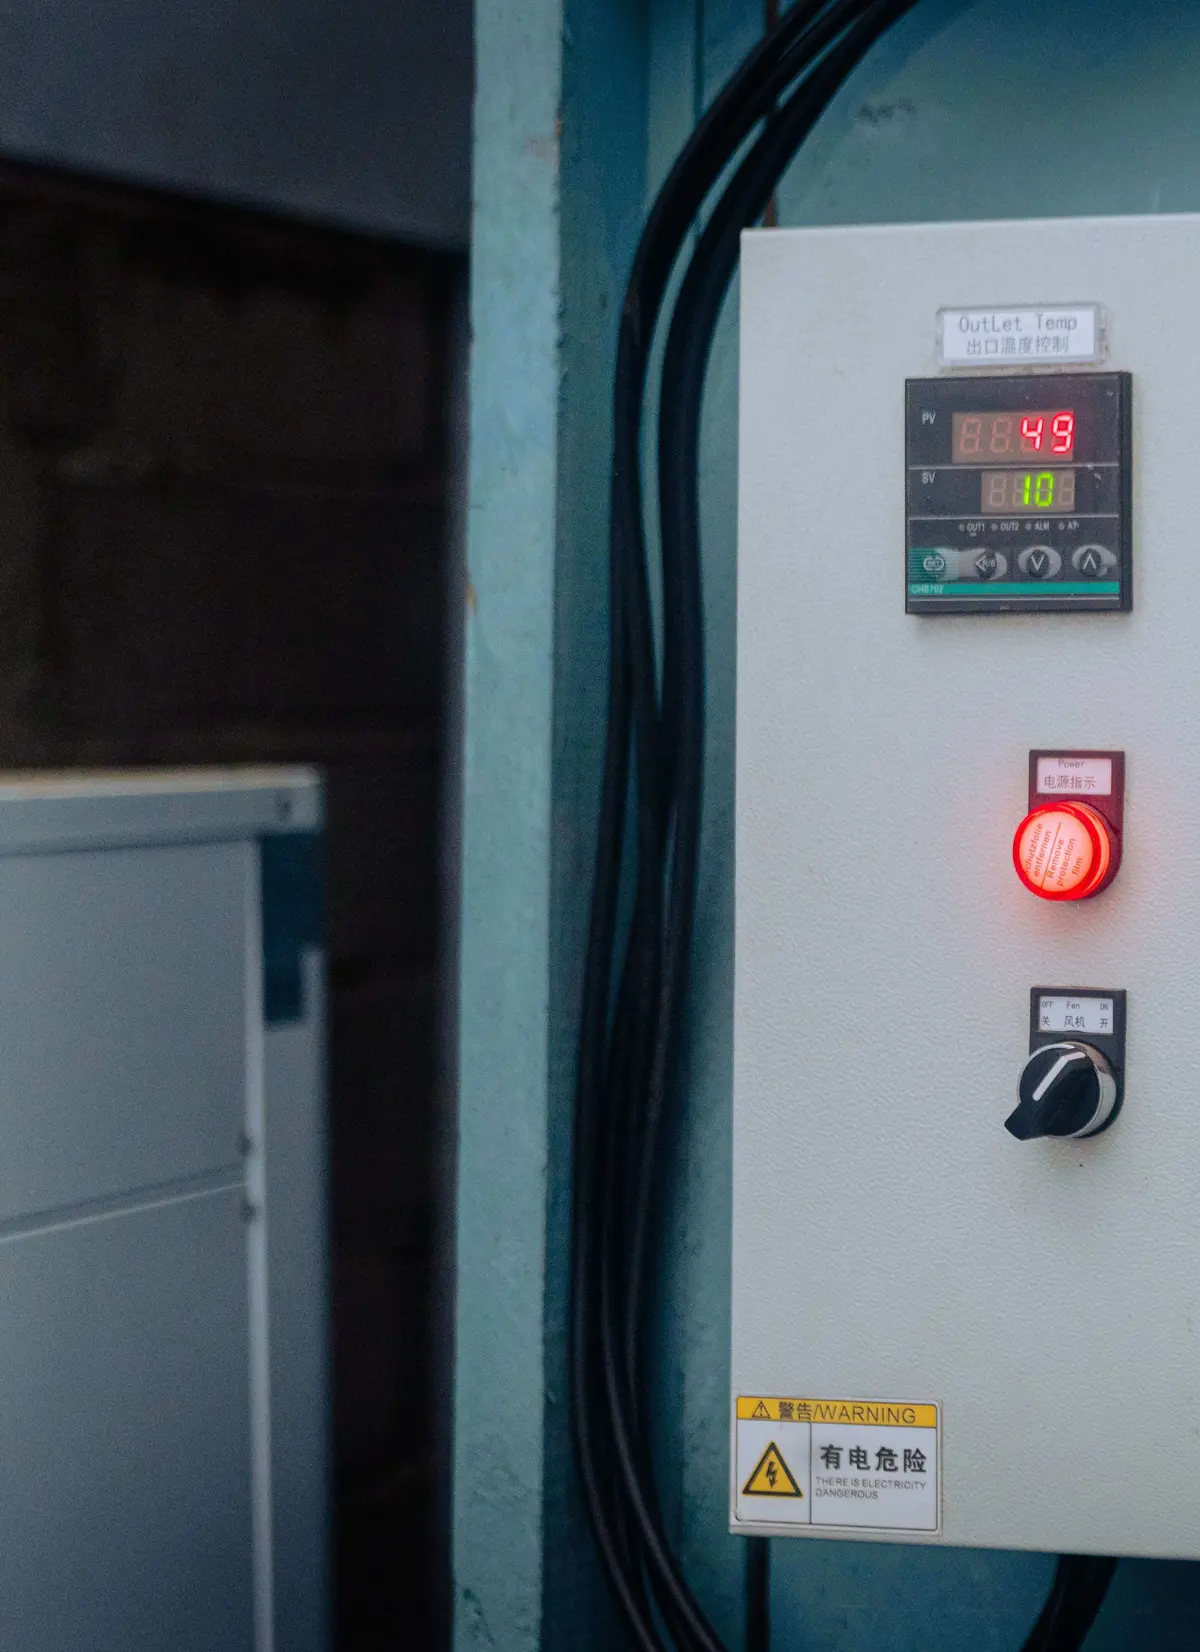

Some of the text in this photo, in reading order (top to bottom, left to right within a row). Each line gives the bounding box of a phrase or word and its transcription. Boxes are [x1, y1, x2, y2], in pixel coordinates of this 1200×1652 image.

[1036, 314, 1077, 332] Temp
[966, 336, 1069, 356] 出口温度控制
[922, 412, 936, 425] PV
[1020, 411, 1075, 453] 49
[922, 472, 936, 484] SV
[1022, 472, 1055, 507] 10
[967, 521, 985, 532] OUT1
[1000, 521, 1020, 532] OUT2
[1035, 521, 1050, 531] ALM
[1058, 759, 1085, 769] Power
[1044, 775, 1096, 789] 电源指示
[1047, 839, 1065, 879] Remove
[1057, 838, 1077, 888] protection
[1041, 1001, 1109, 1011] OFF Fan ON
[1042, 1015, 1109, 1029] 关 风机 开
[778, 1401, 916, 1424] 警告/WARNING
[820, 1444, 927, 1473] 有电危险
[816, 1476, 926, 1491] THERE IS ELECTRICITY
[815, 1488, 879, 1500] DANGEROUS
